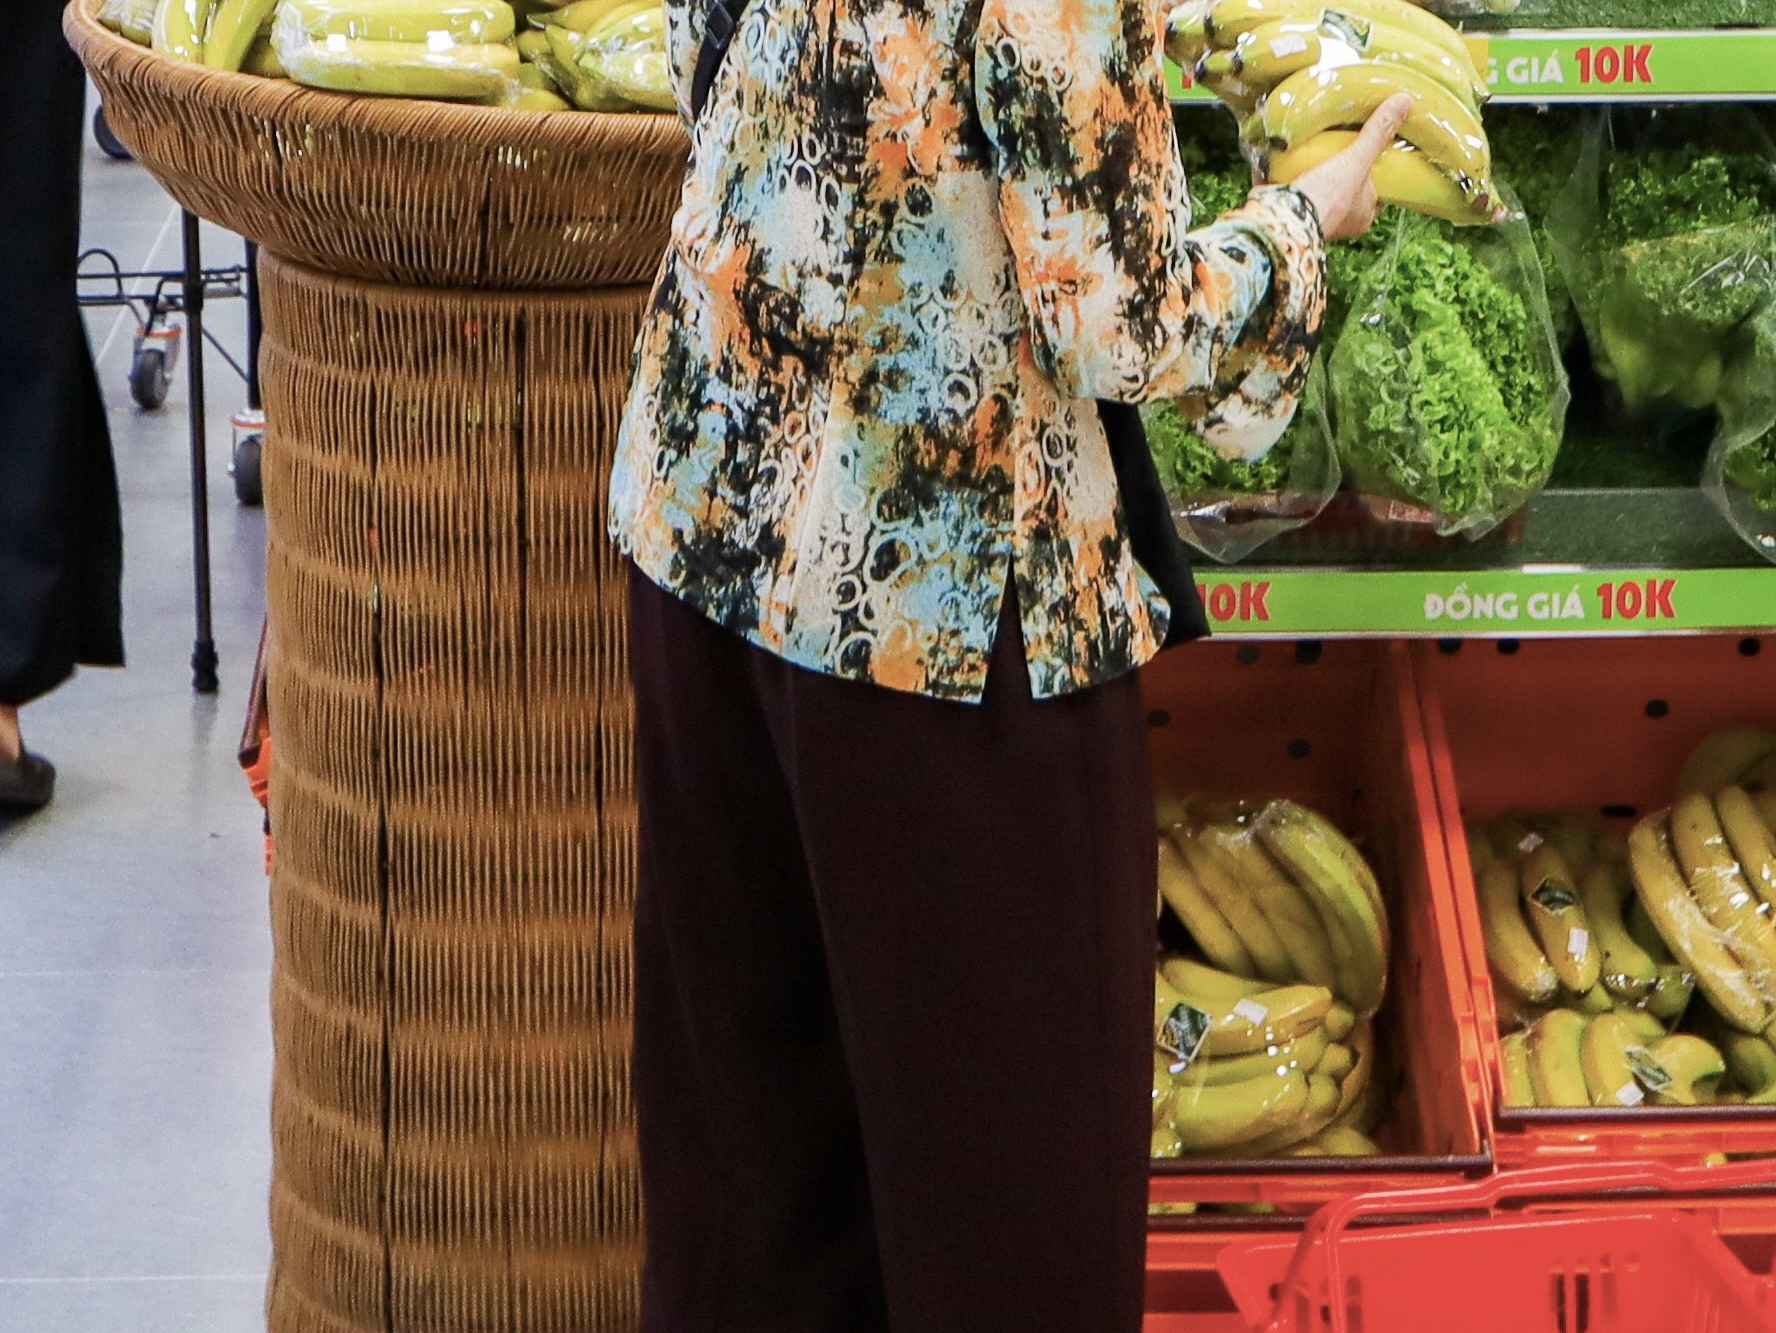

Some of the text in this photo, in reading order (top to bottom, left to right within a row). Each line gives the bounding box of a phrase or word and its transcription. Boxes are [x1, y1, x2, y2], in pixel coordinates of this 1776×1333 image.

[1506, 49, 1564, 85] GIÁ
[1574, 44, 1654, 84] 10K
[1424, 579, 1677, 621] ĐỒNG GIÁ 10K
